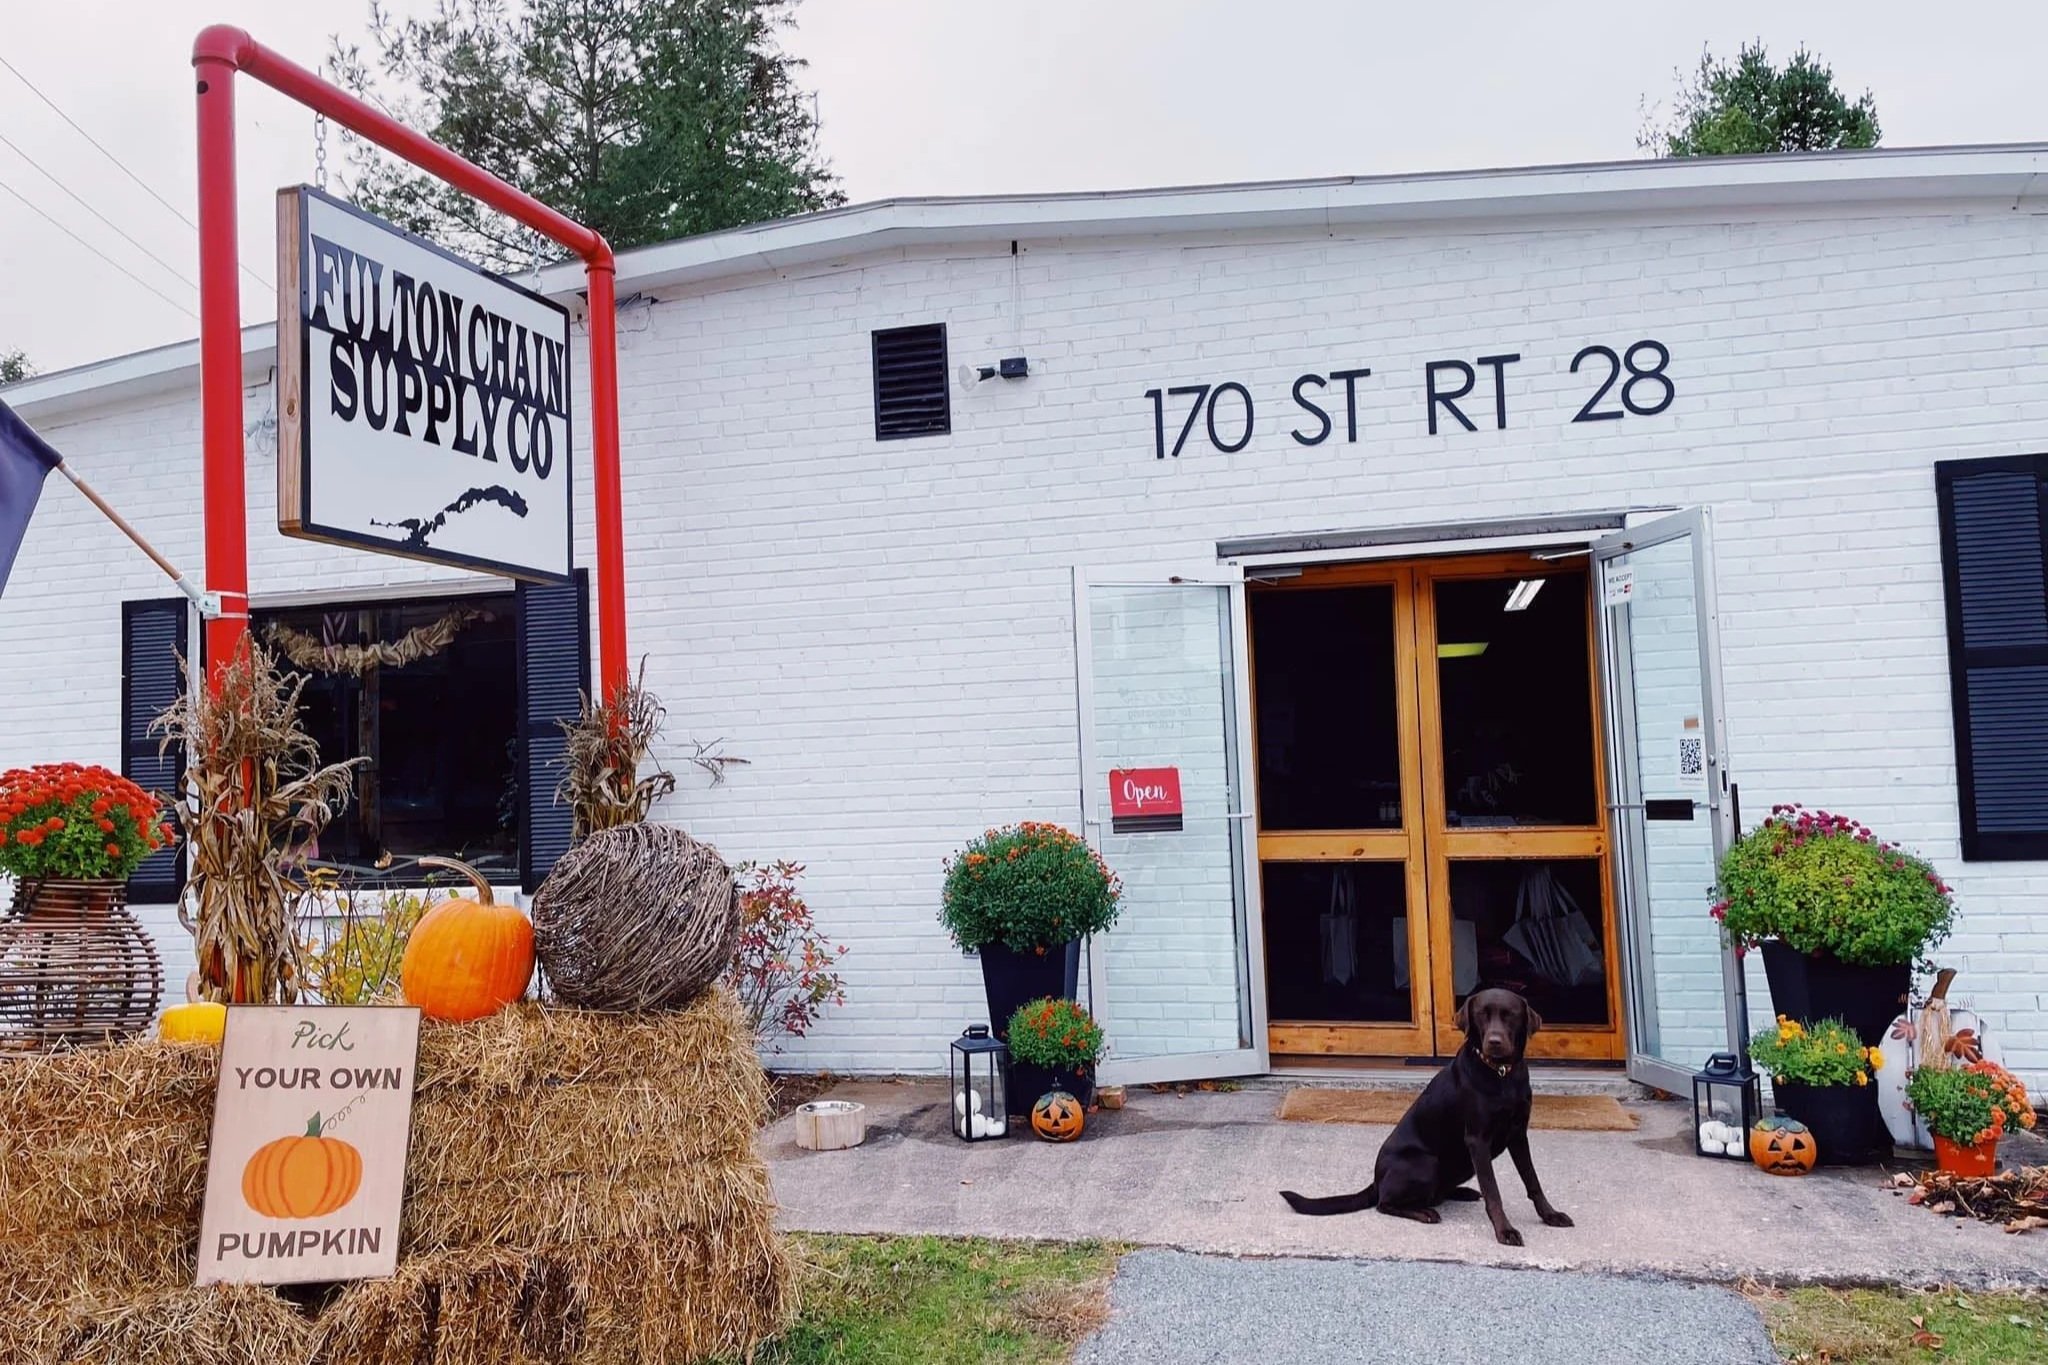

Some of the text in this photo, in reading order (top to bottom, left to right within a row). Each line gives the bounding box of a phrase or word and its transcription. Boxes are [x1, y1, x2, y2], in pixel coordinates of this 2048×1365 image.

[311, 233, 565, 416] FULTON CHAIN
[330, 333, 553, 480] SUPPLY CO
[1144, 339, 1675, 460] 170 ST RT 28
[1123, 779, 1168, 809] Open
[291, 1020, 355, 1051] Pick
[235, 1067, 402, 1090] YOUR OWN
[216, 1227, 381, 1261] PUMPKIN
